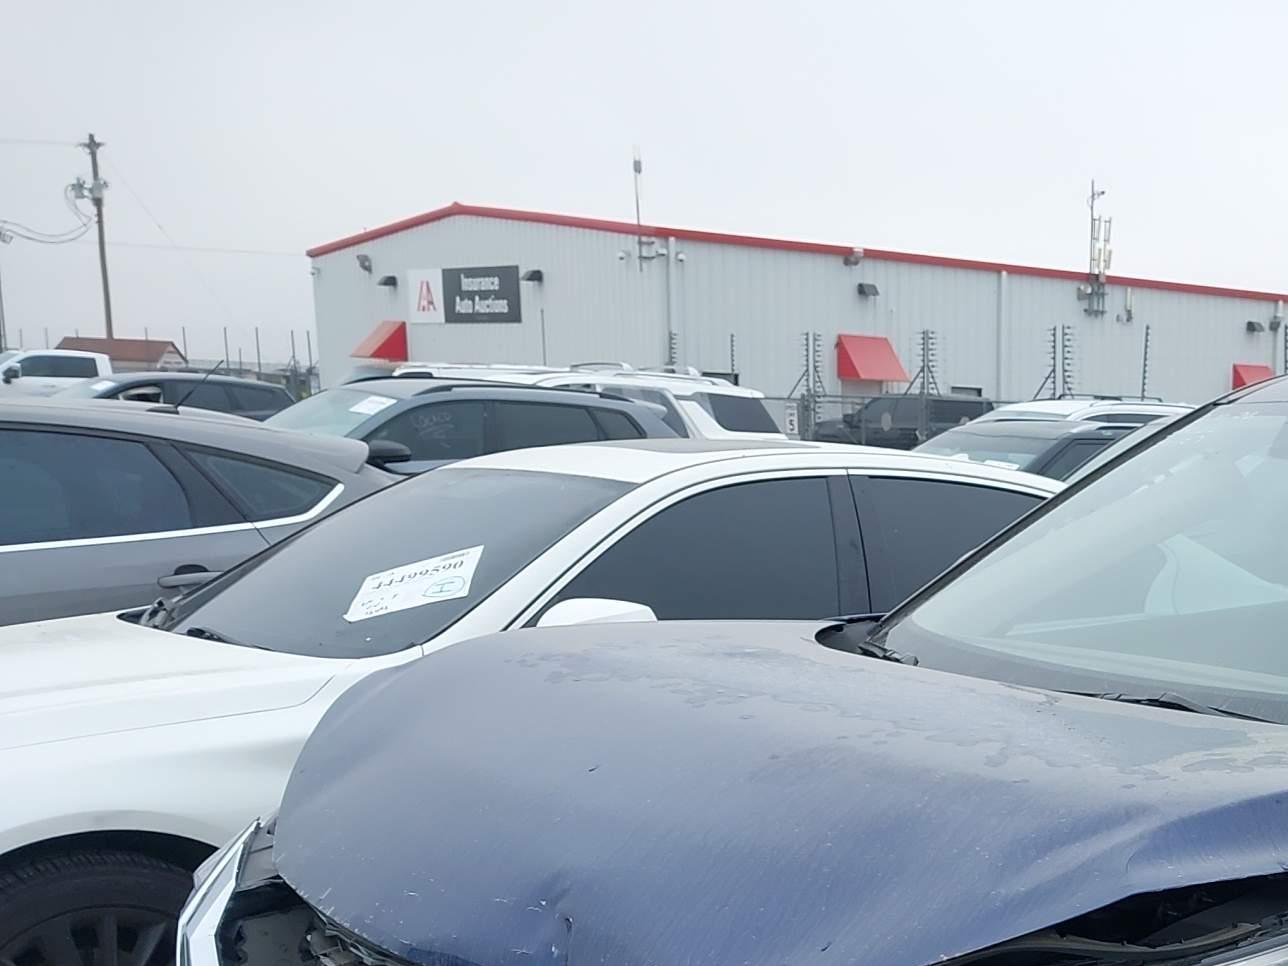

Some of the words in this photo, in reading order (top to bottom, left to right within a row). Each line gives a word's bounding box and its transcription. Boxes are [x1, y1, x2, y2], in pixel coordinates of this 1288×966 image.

[460, 273, 500, 291] Insurance
[455, 295, 473, 313] Auto
[474, 294, 509, 313] Auctions
